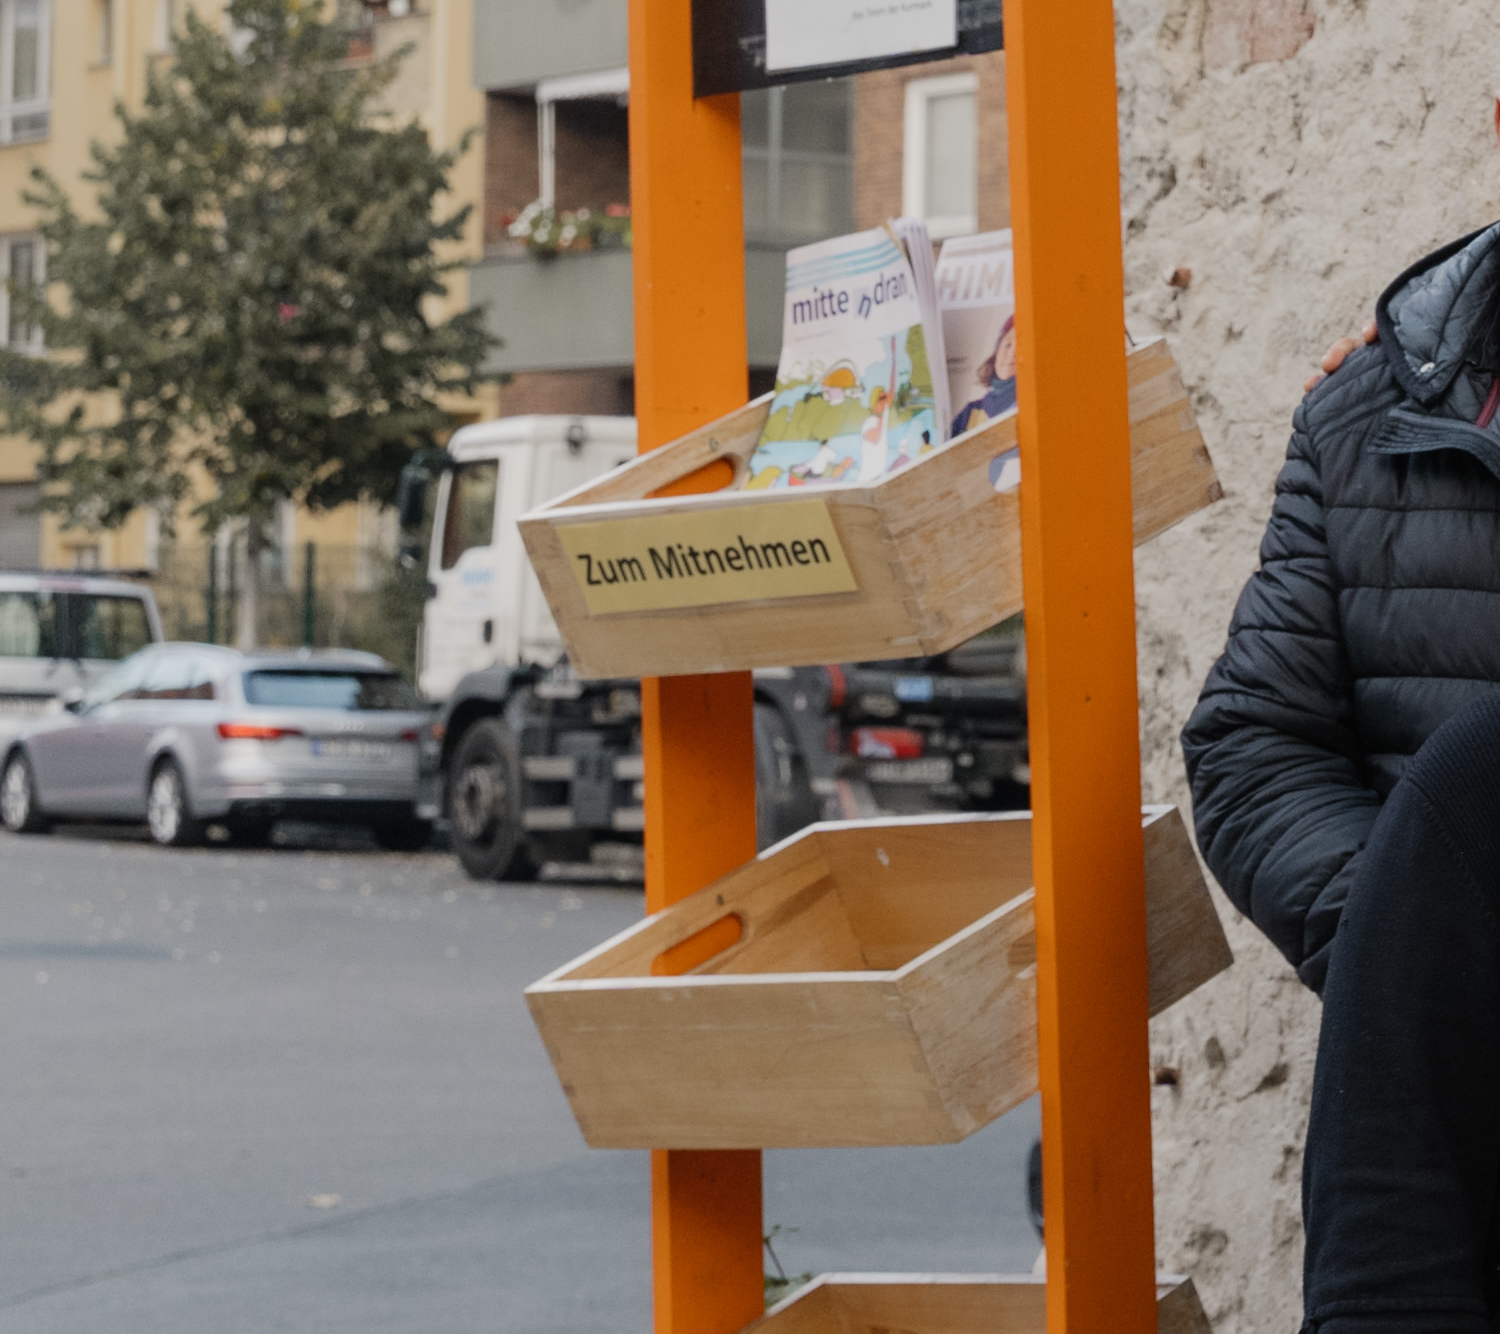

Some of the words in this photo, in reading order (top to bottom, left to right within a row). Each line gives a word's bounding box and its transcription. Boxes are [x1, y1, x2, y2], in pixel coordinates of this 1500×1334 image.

[792, 285, 849, 325] mitte
[578, 553, 646, 585] Zum
[648, 535, 831, 582] Mitnehmen
